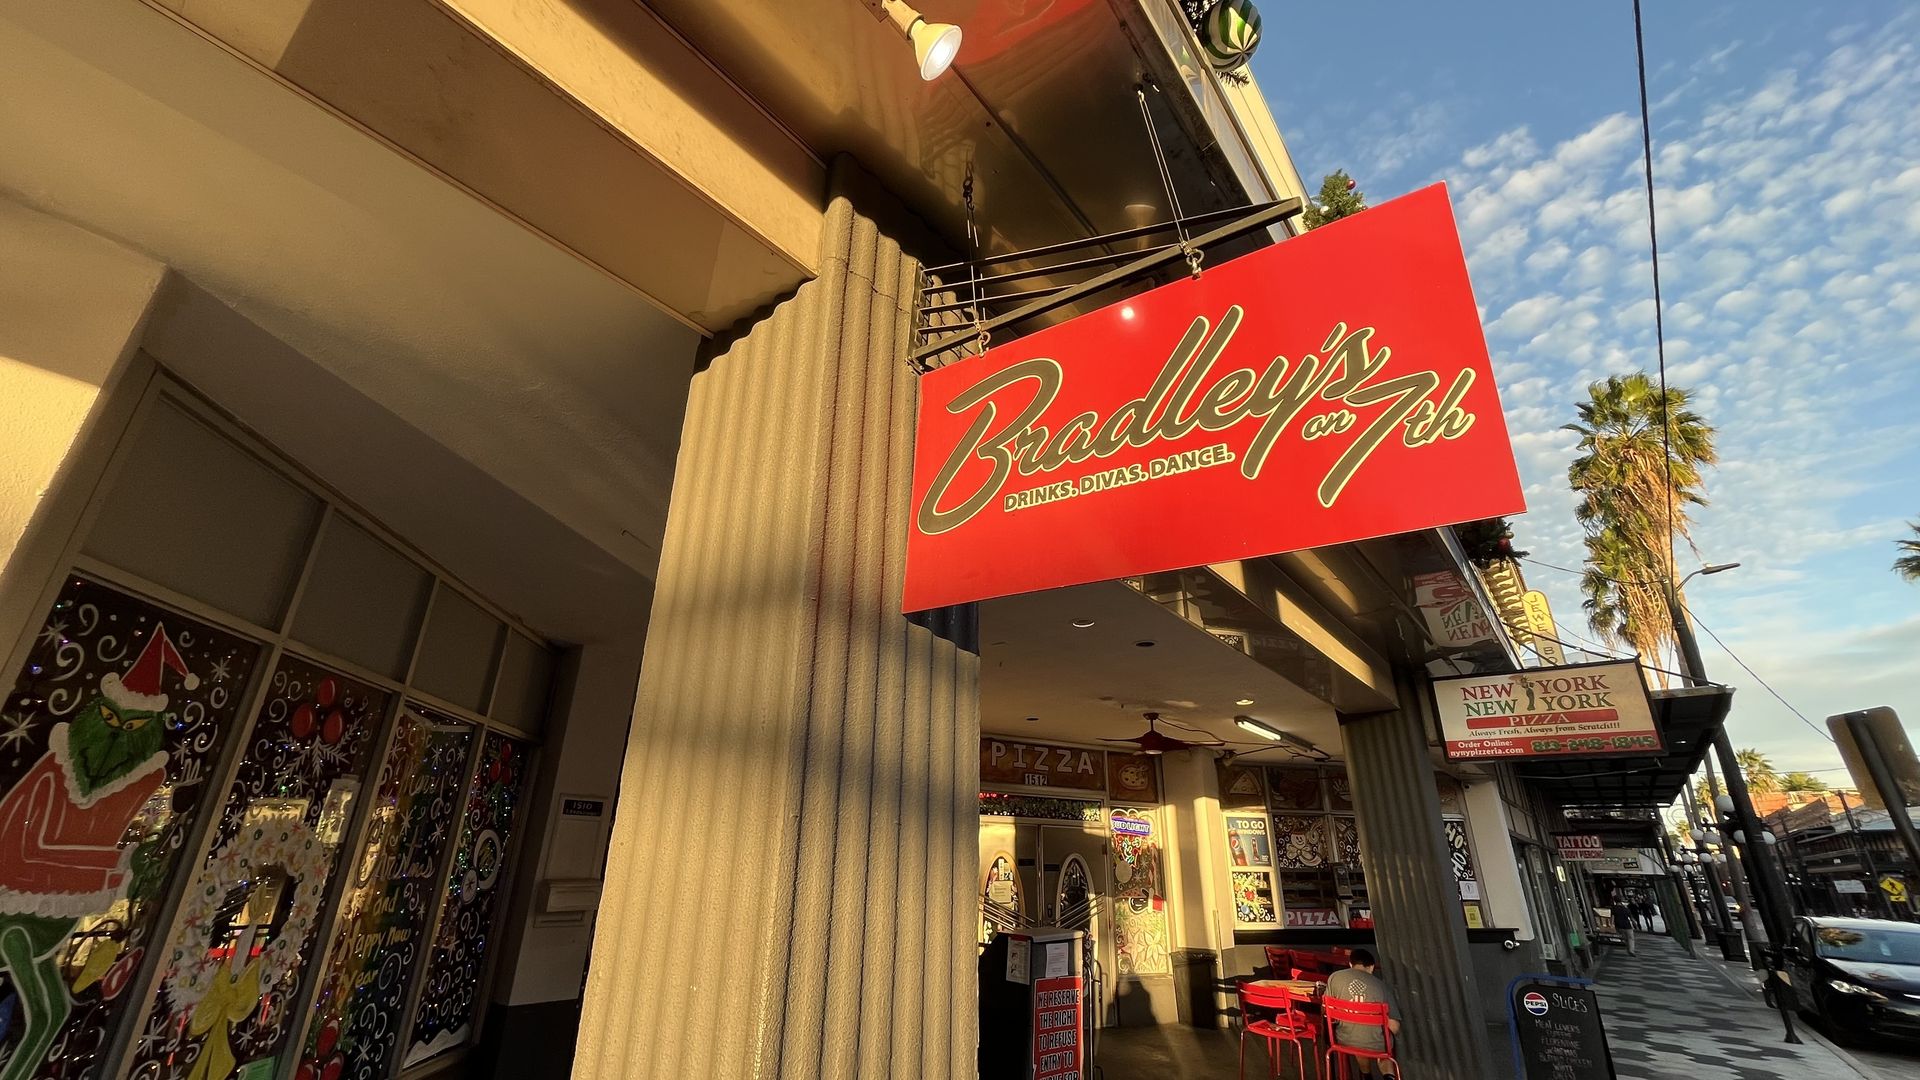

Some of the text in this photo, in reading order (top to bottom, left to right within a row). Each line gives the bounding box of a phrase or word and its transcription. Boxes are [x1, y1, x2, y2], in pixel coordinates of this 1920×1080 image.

[918, 304, 1392, 536] Bradley's
[1302, 367, 1477, 508] on 7th
[1004, 443, 1236, 512] DRINKS. DIVAS. DANCE.
[1460, 674, 1610, 701] NEW YORK
[1463, 691, 1615, 717] NEW YORK
[1508, 713, 1570, 726] PIZZA
[1469, 730, 1496, 739] Always
[1524, 726, 1552, 735] Always
[1555, 725, 1576, 734] from
[991, 741, 1094, 775] PIZZA
[1450, 747, 1524, 757] nynypizzeria.com
[1236, 820, 1265, 829] TO GO
[1556, 835, 1600, 848] TATTOO
[1285, 910, 1340, 926] PIZZA
[1037, 988, 1080, 1009] WE RESERVE
[1525, 1000, 1547, 1008] PEPSI
[1040, 1008, 1077, 1030] THE RIGHT
[1039, 1029, 1077, 1052] TO REFUSE
[1040, 1050, 1074, 1074] ENTRY TO
